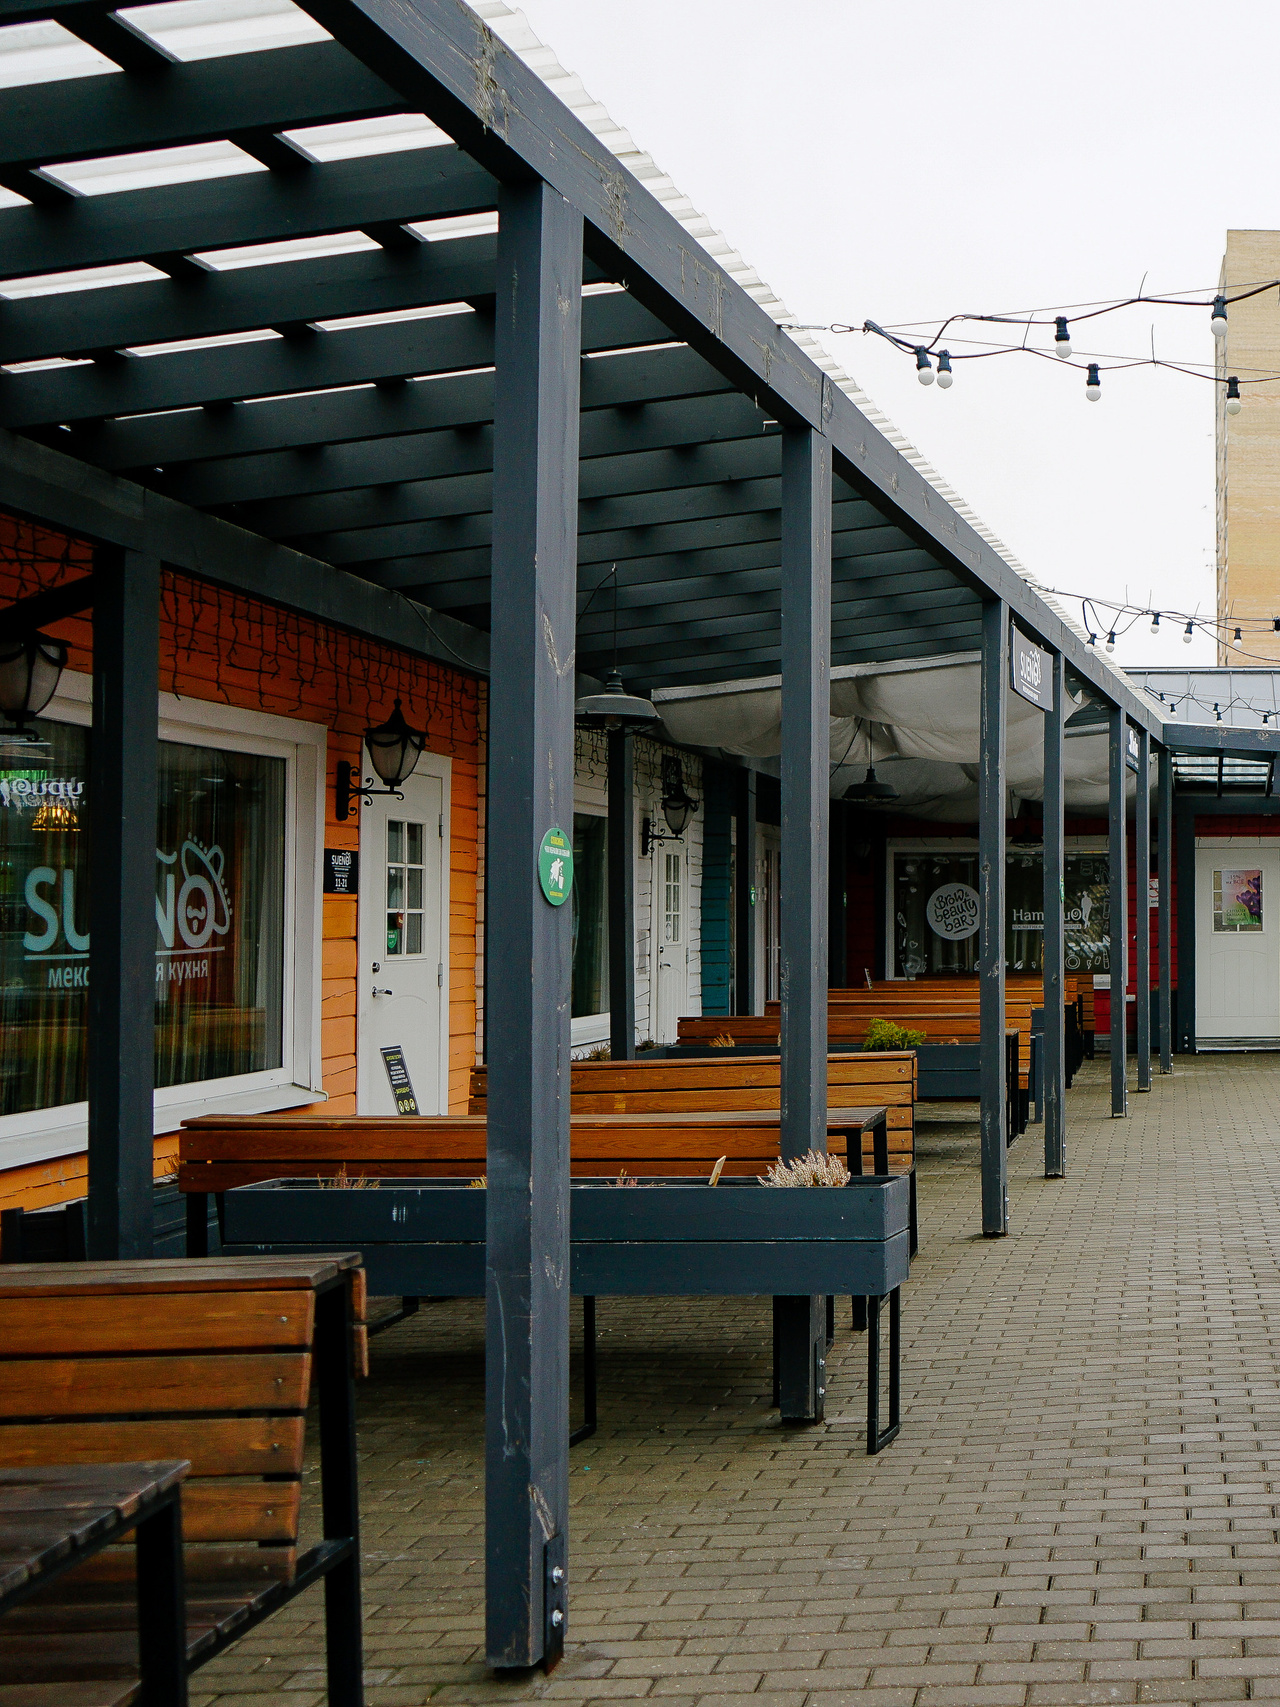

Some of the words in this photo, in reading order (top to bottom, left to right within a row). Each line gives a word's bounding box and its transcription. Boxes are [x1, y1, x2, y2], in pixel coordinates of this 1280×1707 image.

[934, 889, 964, 909] Brow
[934, 898, 978, 922] beauty
[168, 959, 209, 986] кухня
